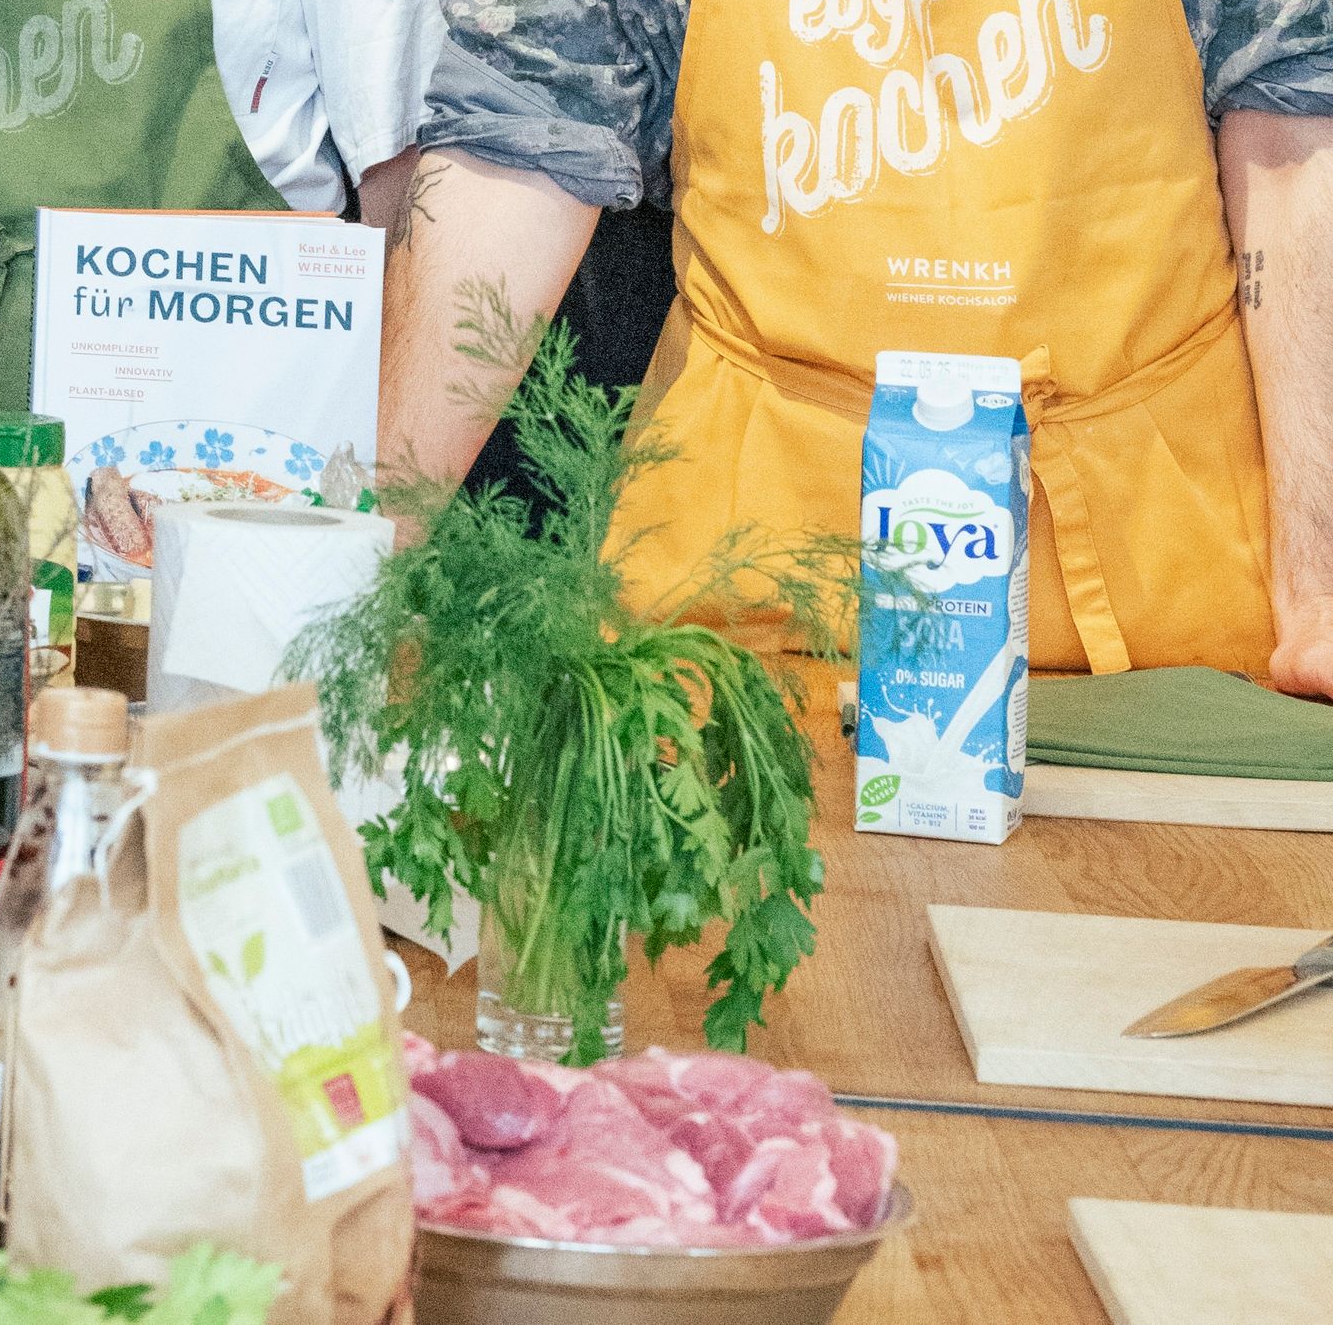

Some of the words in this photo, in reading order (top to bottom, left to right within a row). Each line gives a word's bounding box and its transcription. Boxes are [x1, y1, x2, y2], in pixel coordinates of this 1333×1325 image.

[298, 243, 326, 254] Karl
[329, 244, 341, 255] &
[344, 245, 367, 256] Leo
[75, 244, 268, 285] KOCHEN
[298, 262, 366, 275] WRENKH
[886, 257, 1012, 282] WRENKH
[886, 291, 935, 306] WIENER
[937, 293, 1017, 307] KOCHSALON
[73, 285, 134, 318] für
[148, 289, 354, 332] MORGEN
[71, 342, 161, 355] UNKOMPLIZIERT
[114, 366, 174, 379] INNOVATIV
[68, 386, 145, 399] PLANT-BASED
[896, 669, 918, 685] 0%
[919, 671, 965, 689] SUGAR
[864, 777, 894, 799] PLANT
[908, 811, 947, 820] VITAMINS
